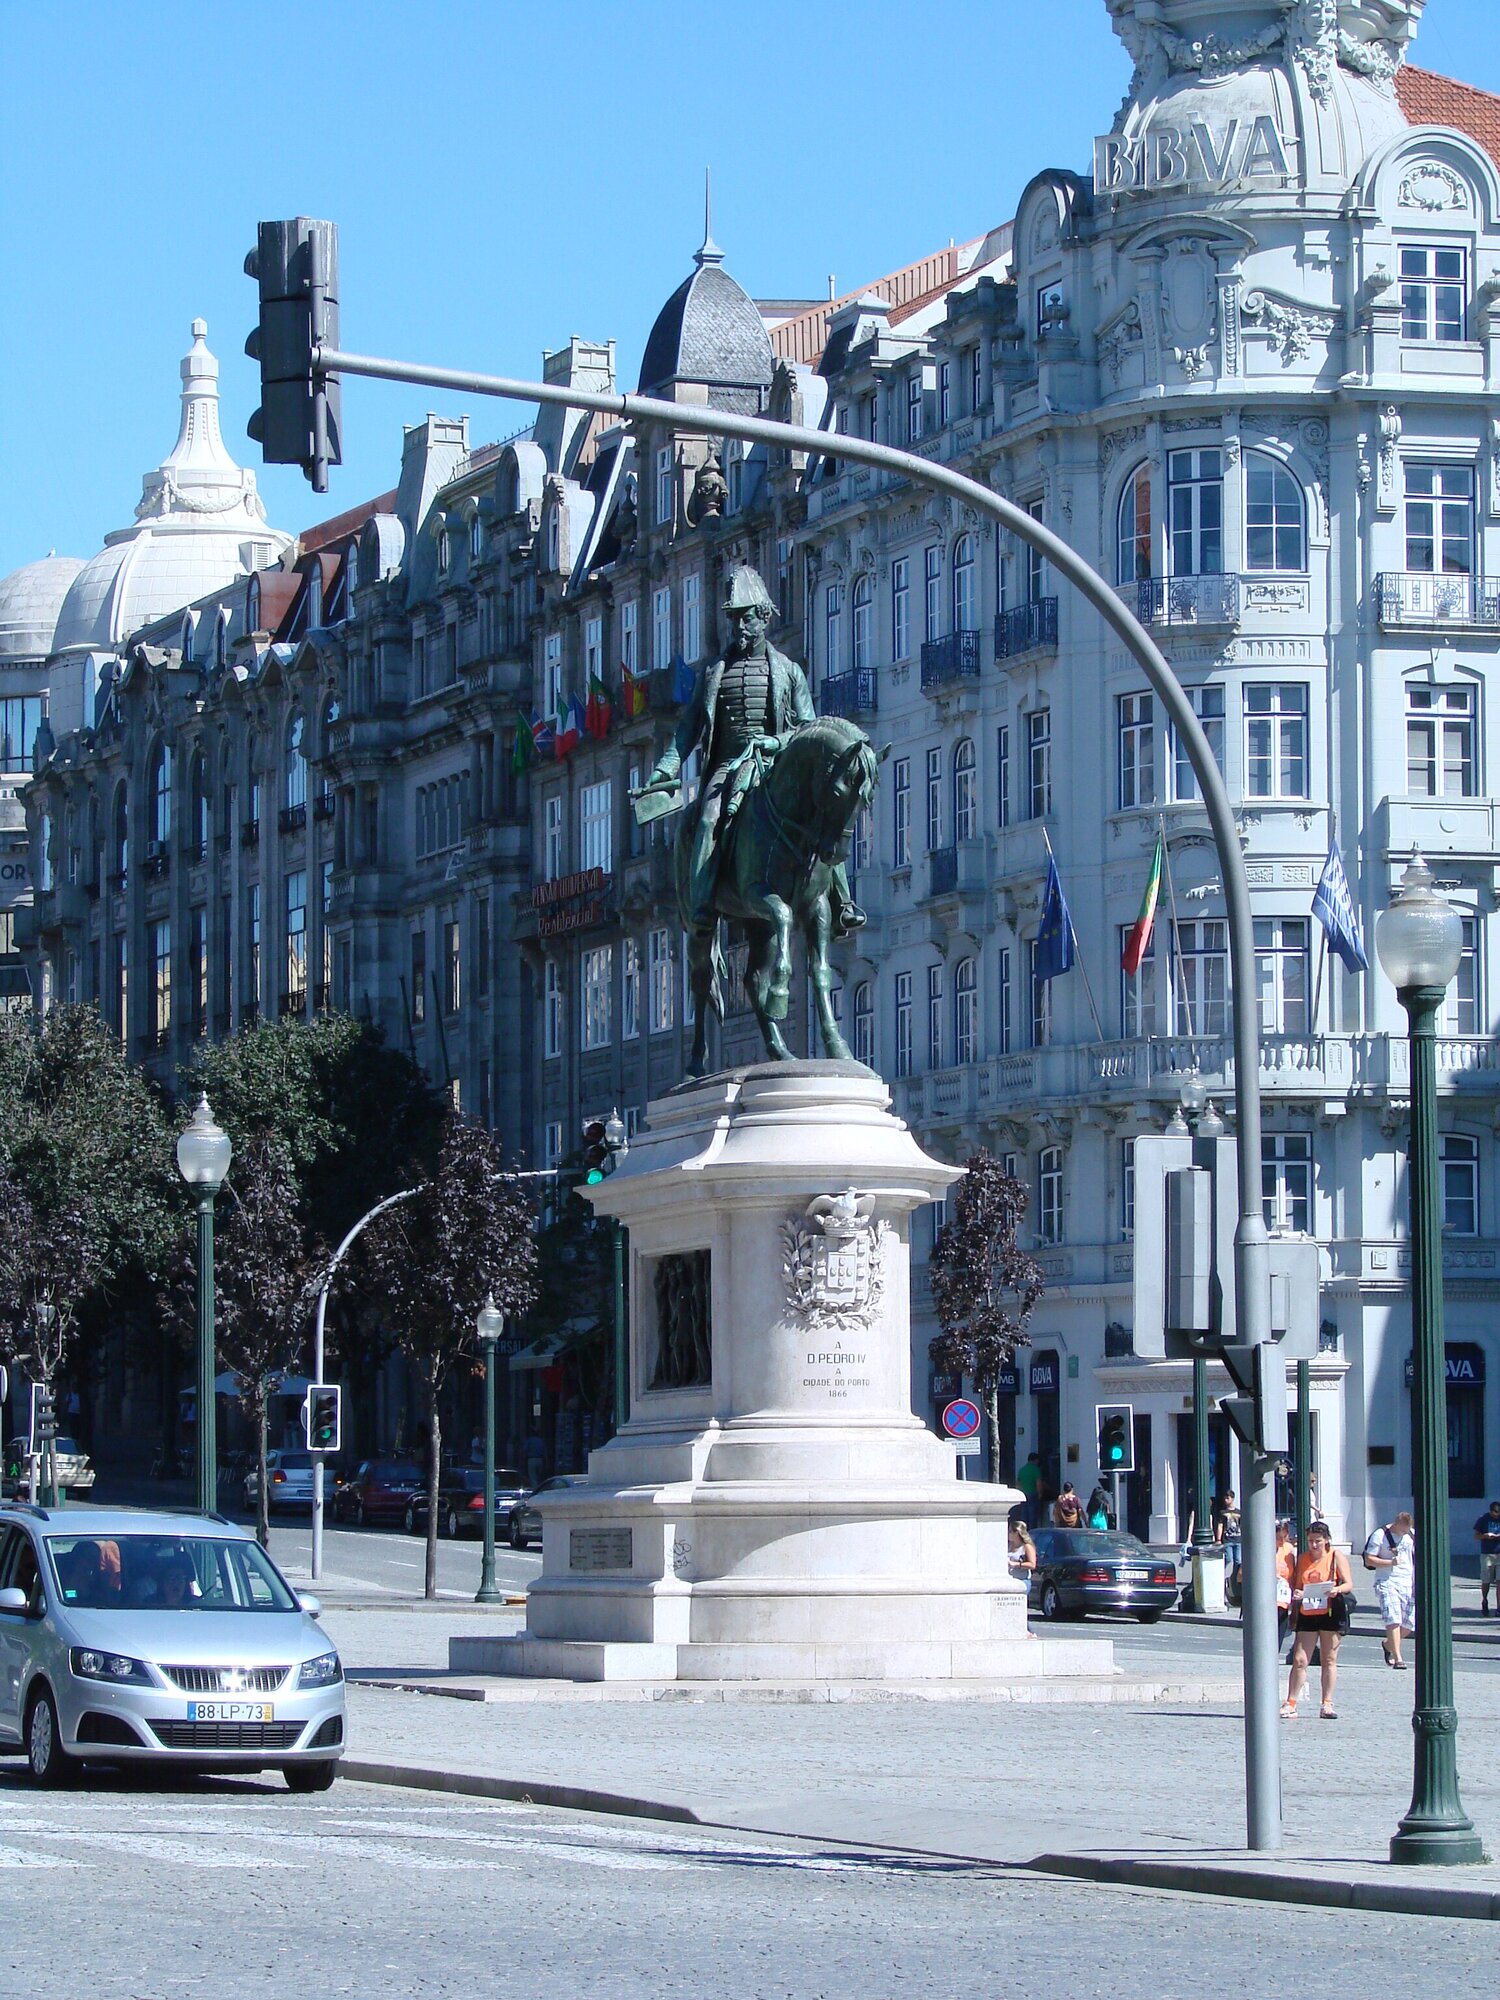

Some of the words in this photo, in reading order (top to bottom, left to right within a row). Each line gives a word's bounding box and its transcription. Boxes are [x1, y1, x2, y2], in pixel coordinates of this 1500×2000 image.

[1094, 115, 1291, 195] BBVA
[835, 1341, 842, 1350] A
[835, 1367, 842, 1375] A
[802, 1378, 831, 1387] CIDADE
[834, 1378, 845, 1387] DO
[847, 1378, 870, 1387] PORTO
[828, 1389, 847, 1398] 1866
